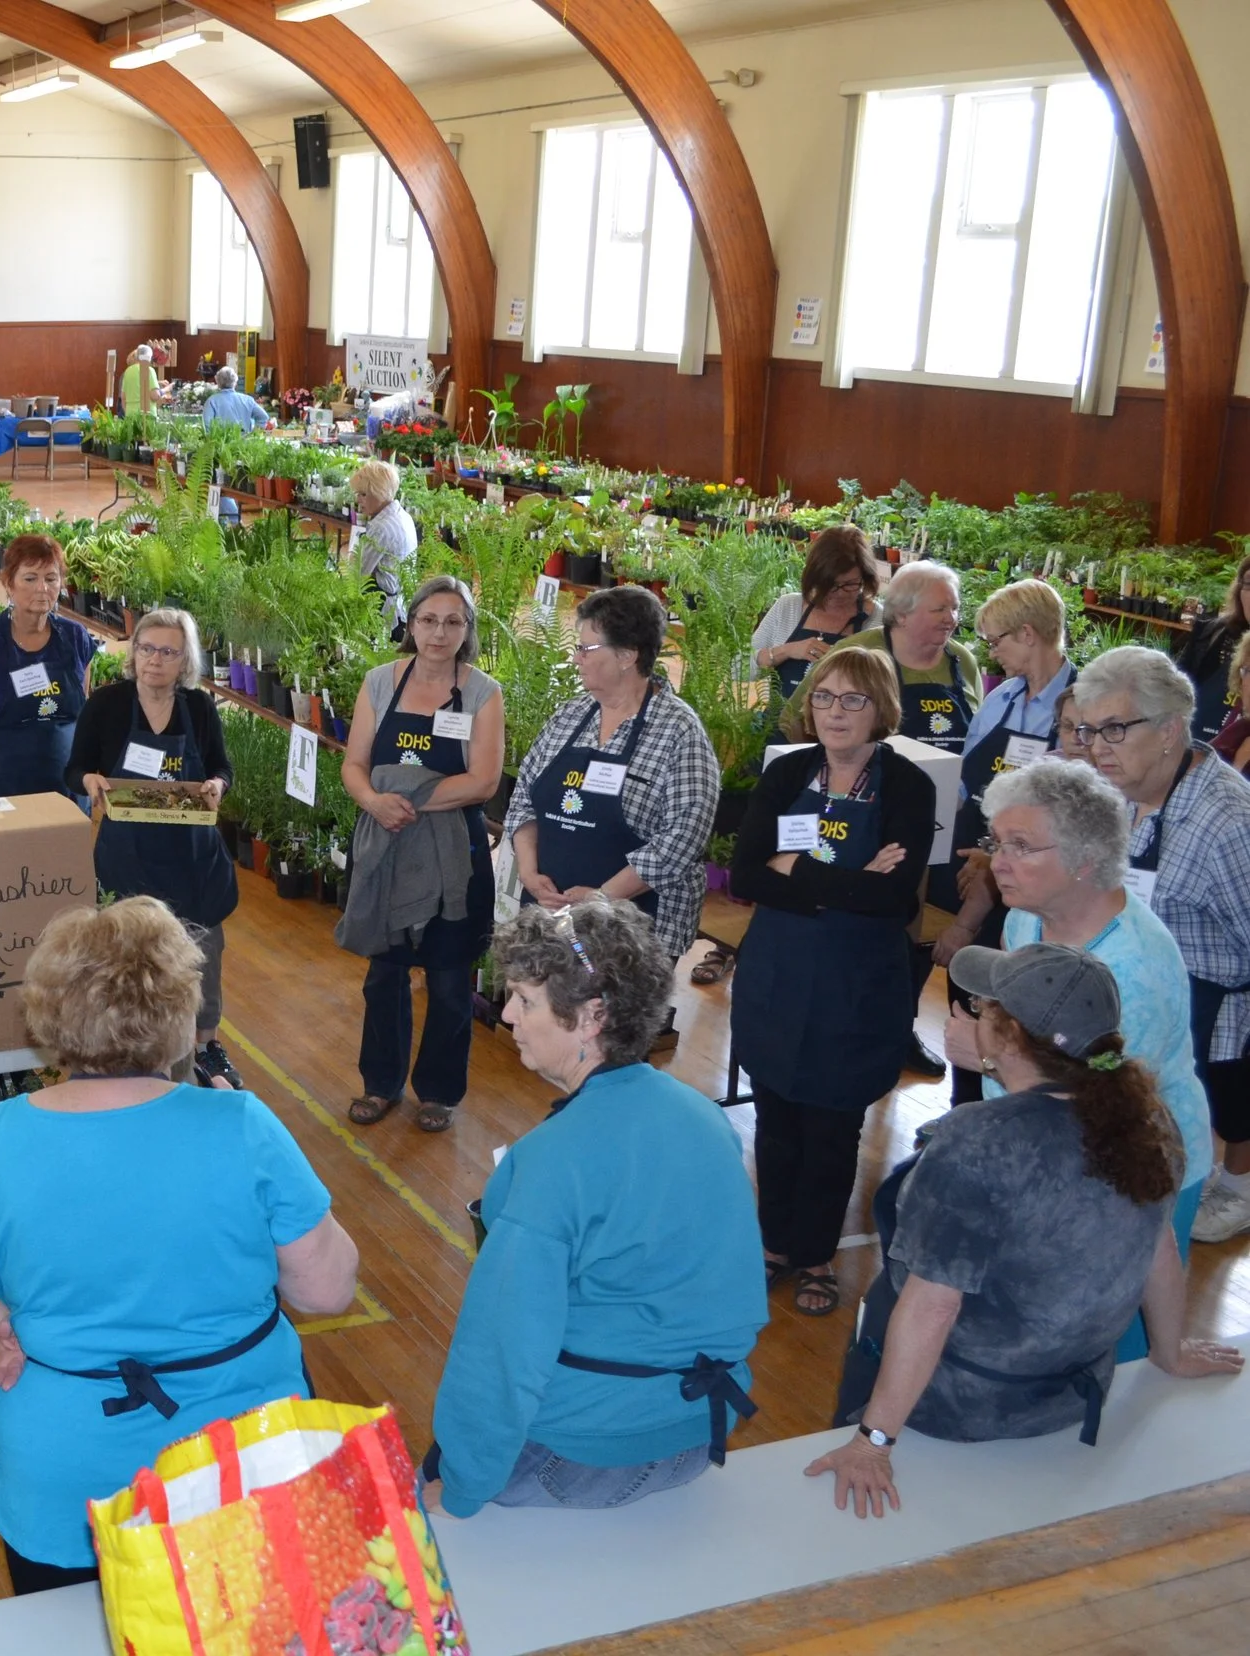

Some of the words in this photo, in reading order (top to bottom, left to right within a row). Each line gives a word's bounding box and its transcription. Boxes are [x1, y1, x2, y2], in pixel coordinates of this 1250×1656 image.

[369, 349, 403, 368] SILENT
[365, 369, 407, 388] AUCTION
[542, 582, 556, 607] B
[920, 699, 954, 713] SDHS
[396, 732, 431, 751] SDHS
[297, 735, 314, 772] F
[818, 819, 848, 840] DHS
